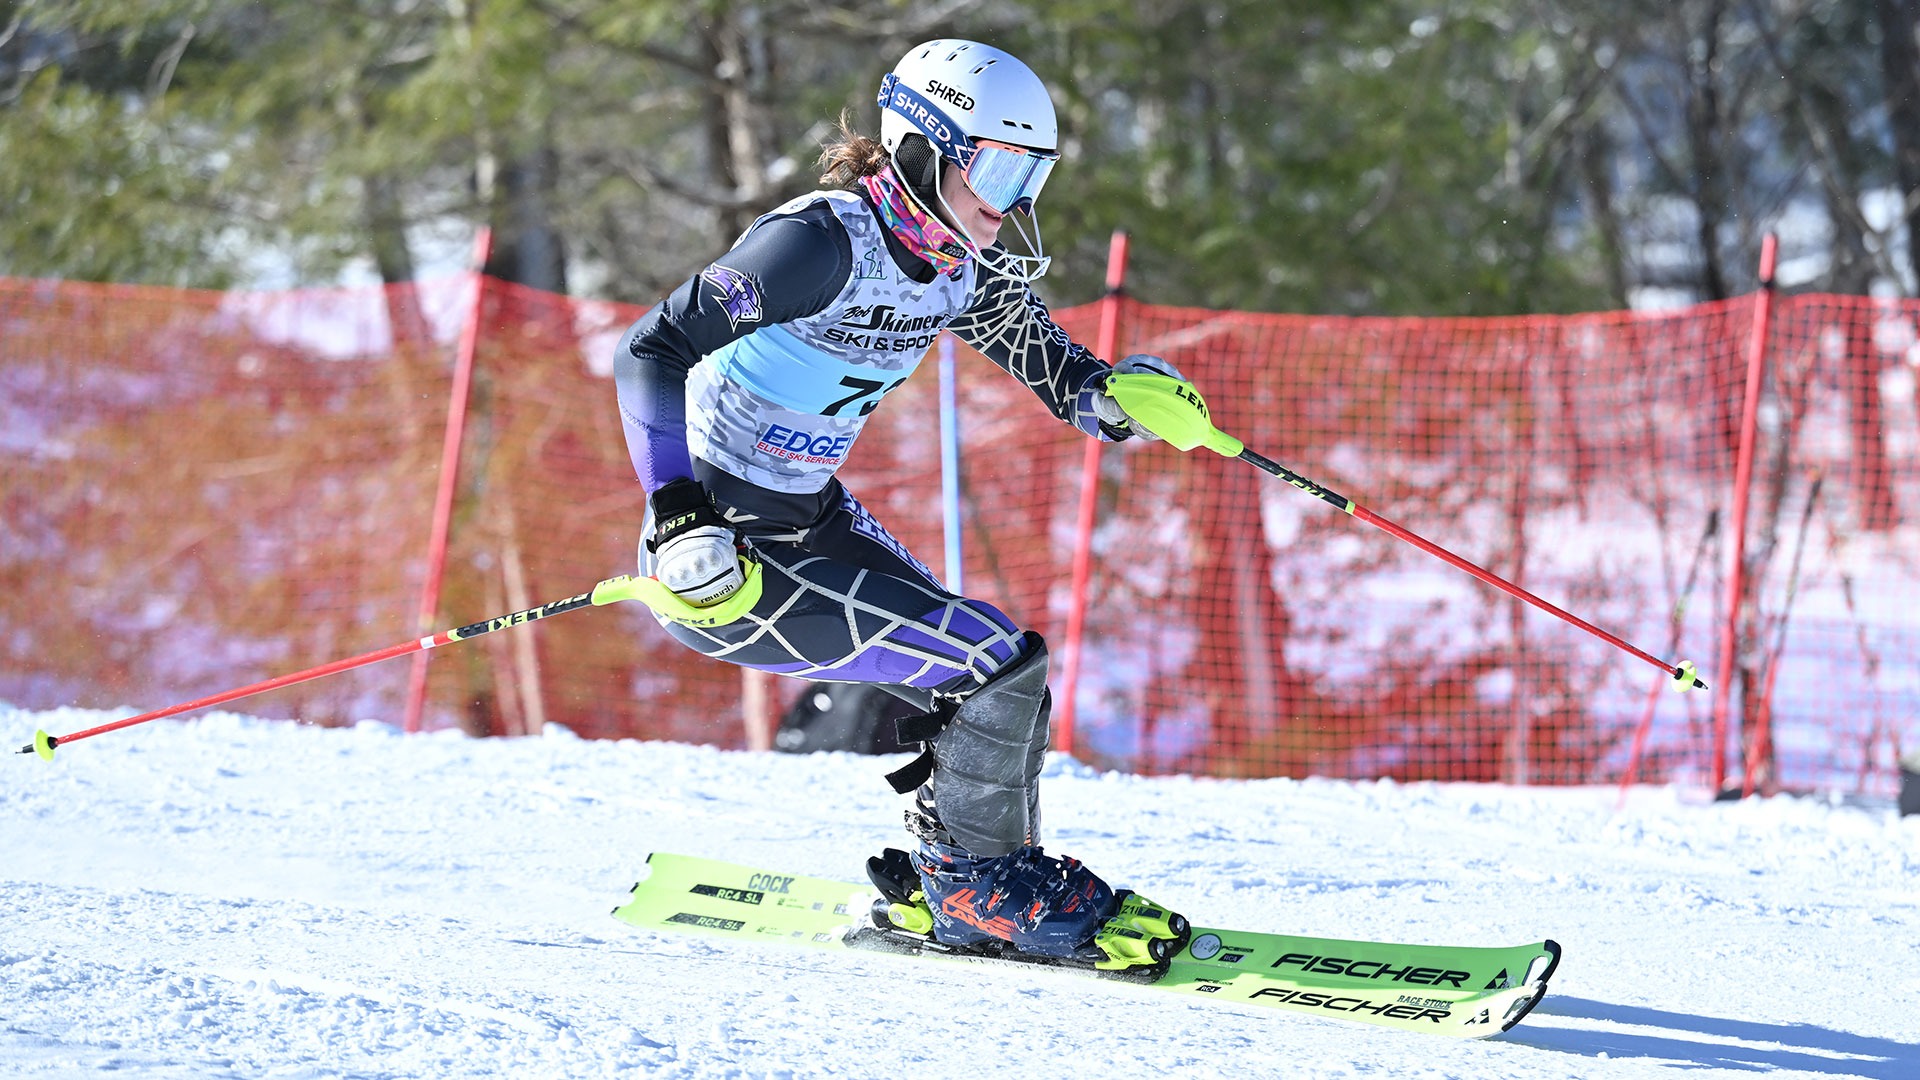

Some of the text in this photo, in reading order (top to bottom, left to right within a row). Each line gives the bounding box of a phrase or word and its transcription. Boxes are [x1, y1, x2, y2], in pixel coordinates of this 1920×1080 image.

[842, 304, 874, 320] Bob
[823, 328, 871, 349] SKI
[873, 337, 889, 351] &
[1175, 384, 1208, 419] LEKI
[761, 423, 849, 458] EDGE
[756, 441, 841, 466] ELITE SKI SERVICE
[661, 512, 697, 534] LEKI
[716, 889, 760, 904] RC4 SL
[696, 916, 738, 931] RC4 SL
[1270, 953, 1471, 988] FISCHER
[1248, 987, 1452, 1023] FISCHER
[1397, 994, 1454, 1010] RACE STOCK
